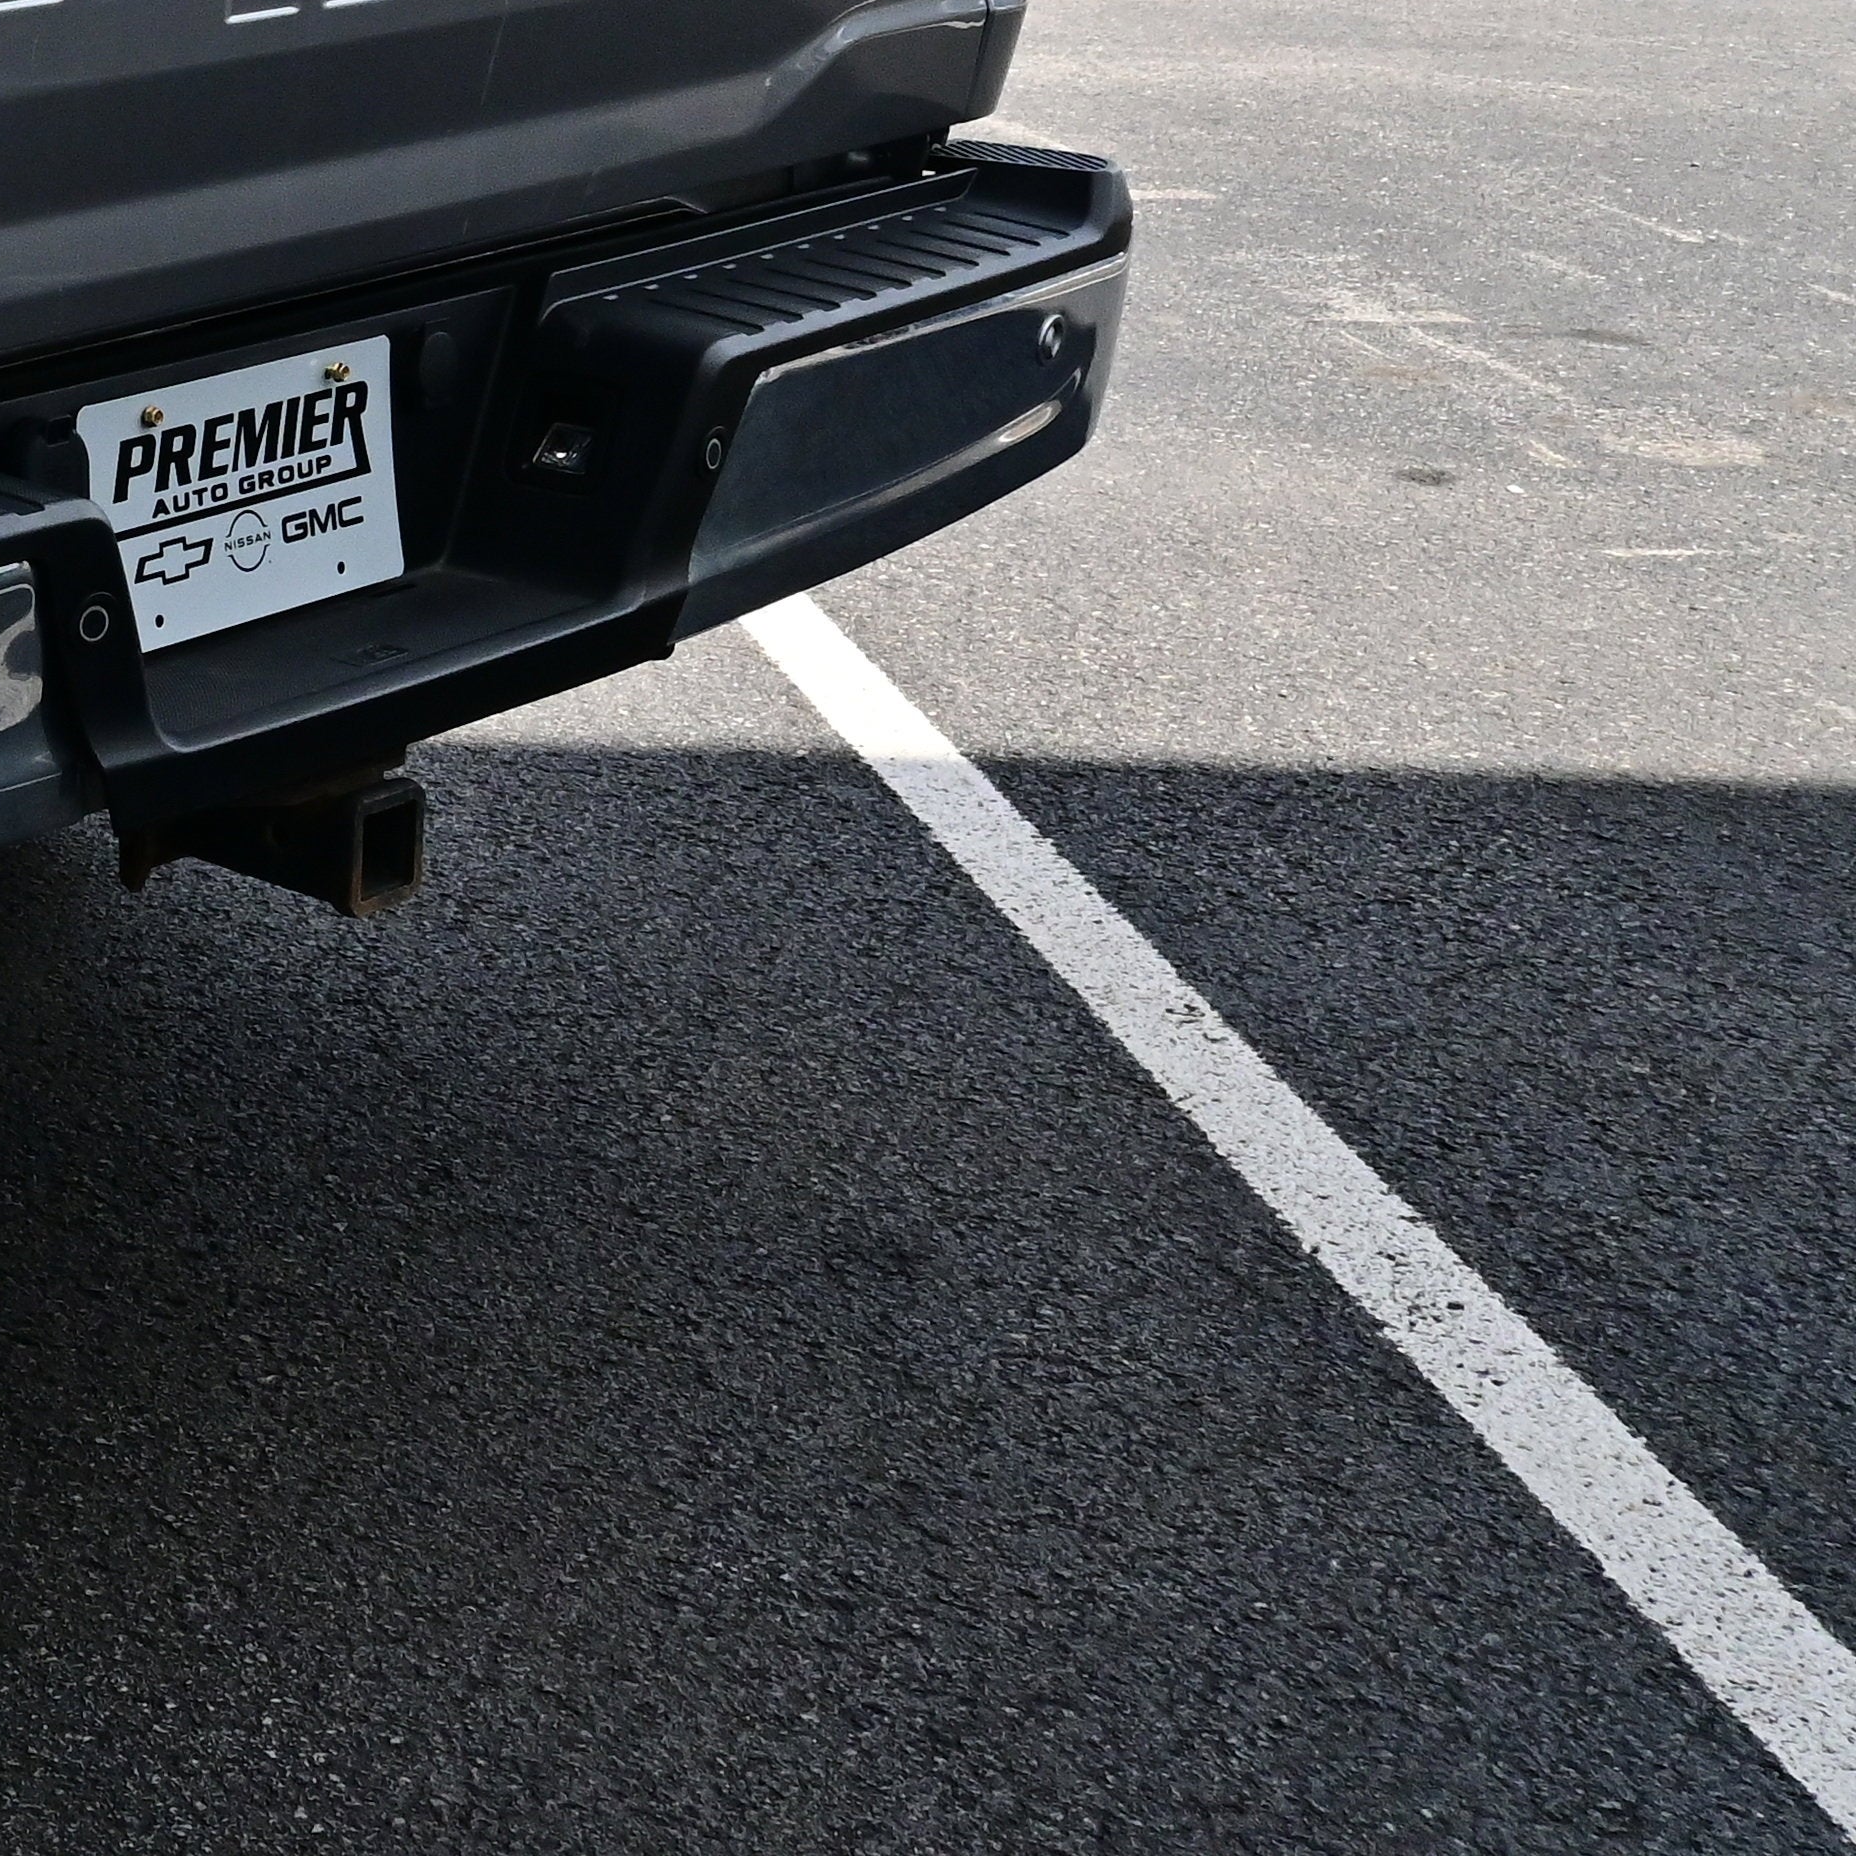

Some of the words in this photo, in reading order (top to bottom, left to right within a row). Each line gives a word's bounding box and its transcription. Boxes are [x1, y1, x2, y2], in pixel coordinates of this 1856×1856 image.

[112, 380, 371, 504] PREMIER
[152, 482, 228, 519] AUTO
[238, 454, 332, 495] GROUP
[224, 530, 271, 552] NISSAN
[281, 496, 365, 544] GMC
